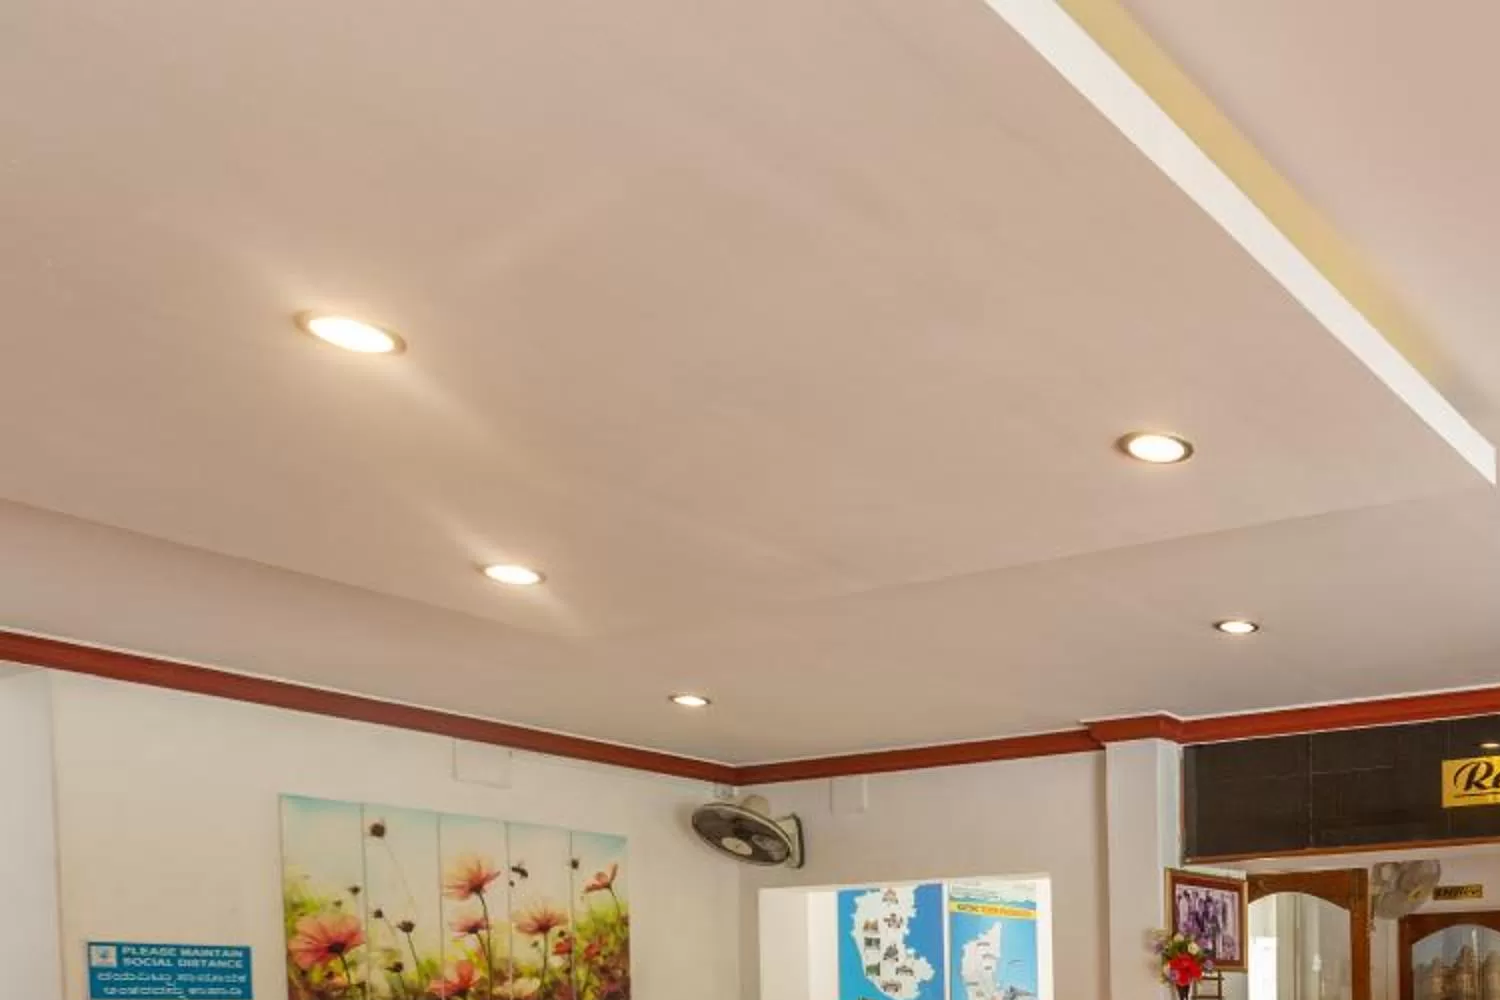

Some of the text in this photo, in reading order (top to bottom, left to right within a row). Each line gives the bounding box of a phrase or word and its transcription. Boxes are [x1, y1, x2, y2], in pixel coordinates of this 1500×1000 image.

[121, 946, 243, 958] PLEASE MAINTAIN
[122, 957, 244, 969] SOCIAL DISTANCE
